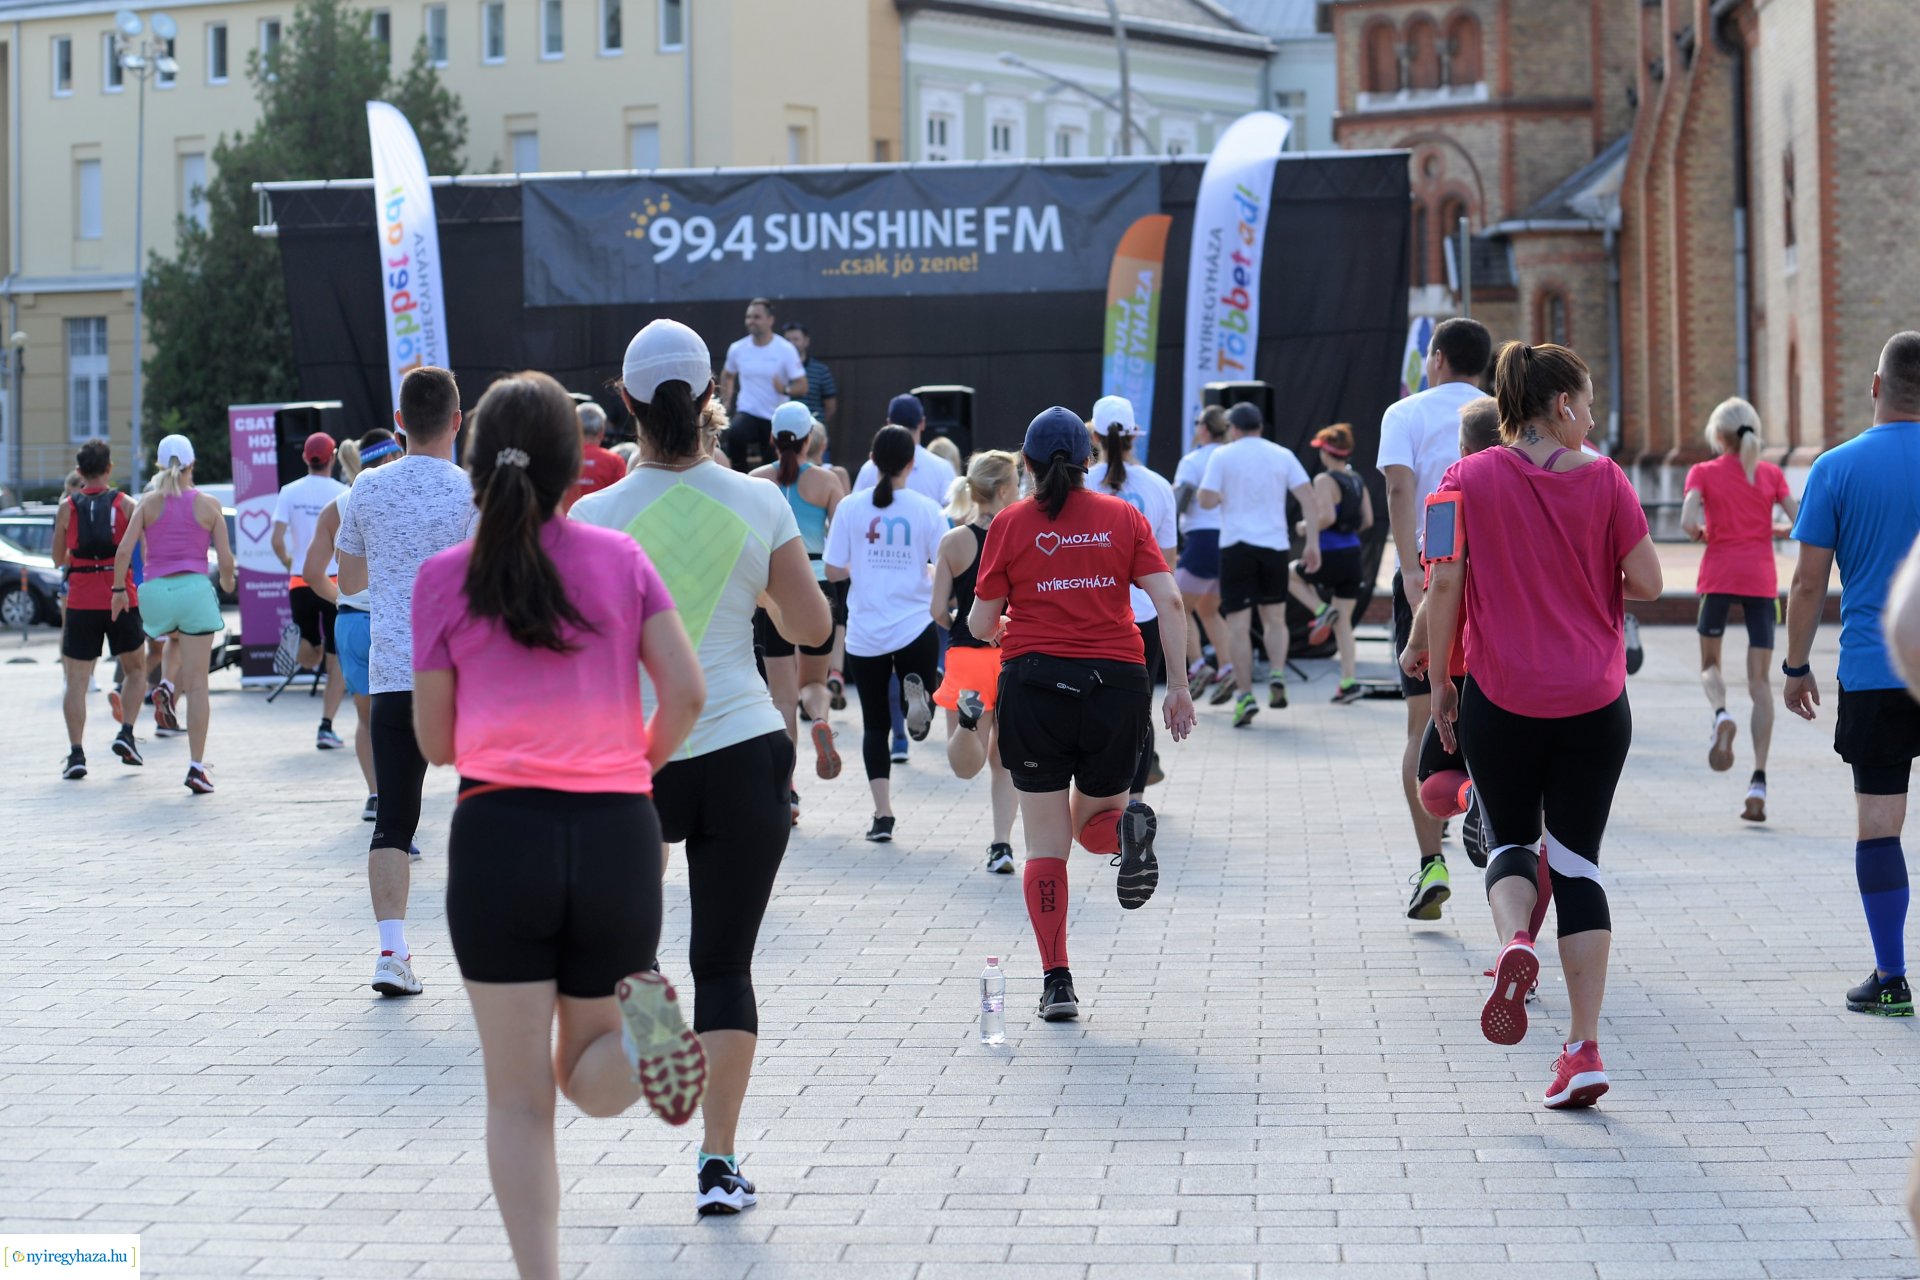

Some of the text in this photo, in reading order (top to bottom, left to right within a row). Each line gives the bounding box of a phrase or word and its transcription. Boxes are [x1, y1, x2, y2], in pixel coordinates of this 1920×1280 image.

[649, 205, 1064, 263] 99.4 SUNSHINE FM
[821, 252, 979, 278] ...csak jó zene!
[1217, 184, 1261, 372] Többet ad!
[1199, 227, 1223, 370] NYÍREGYHÁZA
[1061, 533, 1110, 544] MOZAIK
[1037, 574, 1116, 592] NYÍREGYHÁZA
